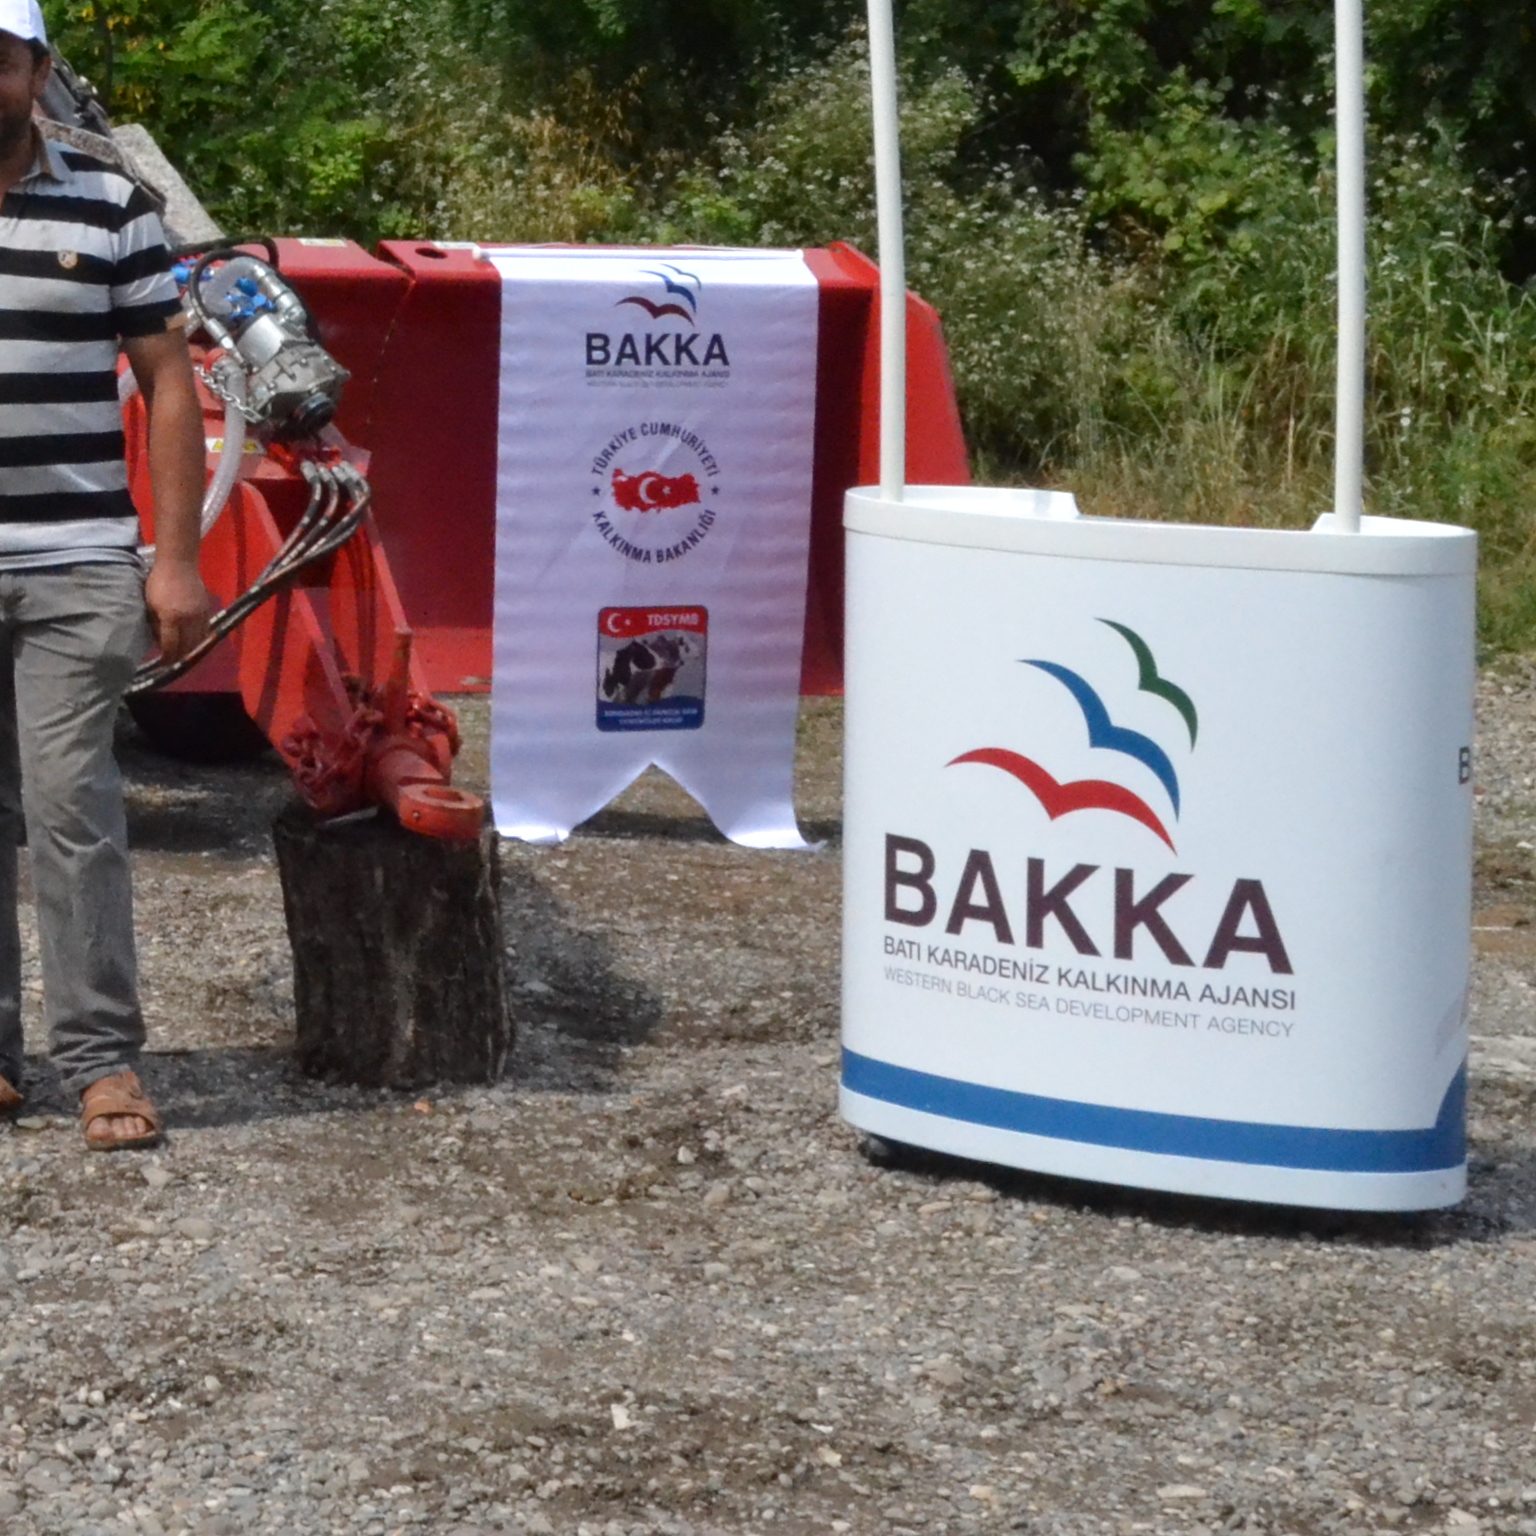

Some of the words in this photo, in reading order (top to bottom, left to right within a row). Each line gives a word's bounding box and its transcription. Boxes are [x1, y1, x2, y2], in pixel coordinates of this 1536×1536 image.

[586, 333, 730, 366] BAKKA
[591, 427, 638, 476] TÜRKİYE
[640, 422, 721, 477] CUMHURİYETİ
[593, 510, 651, 563] KALKINMA
[656, 509, 716, 563] BAKANLIĞI
[647, 613, 699, 626] TDSYMB
[884, 832, 1295, 975] BAKKA
[884, 935, 921, 959] BATI
[927, 944, 1049, 985] KARADENİZ
[1057, 967, 1191, 1002] KALKINMA
[1197, 983, 1296, 1011] AJANSI
[884, 965, 953, 995] WESTERN
[956, 982, 1011, 1005] BLACK
[1016, 992, 1050, 1012] SEA
[1056, 997, 1201, 1031] DEVELOPMENT
[1206, 1016, 1295, 1038] AGENCY
